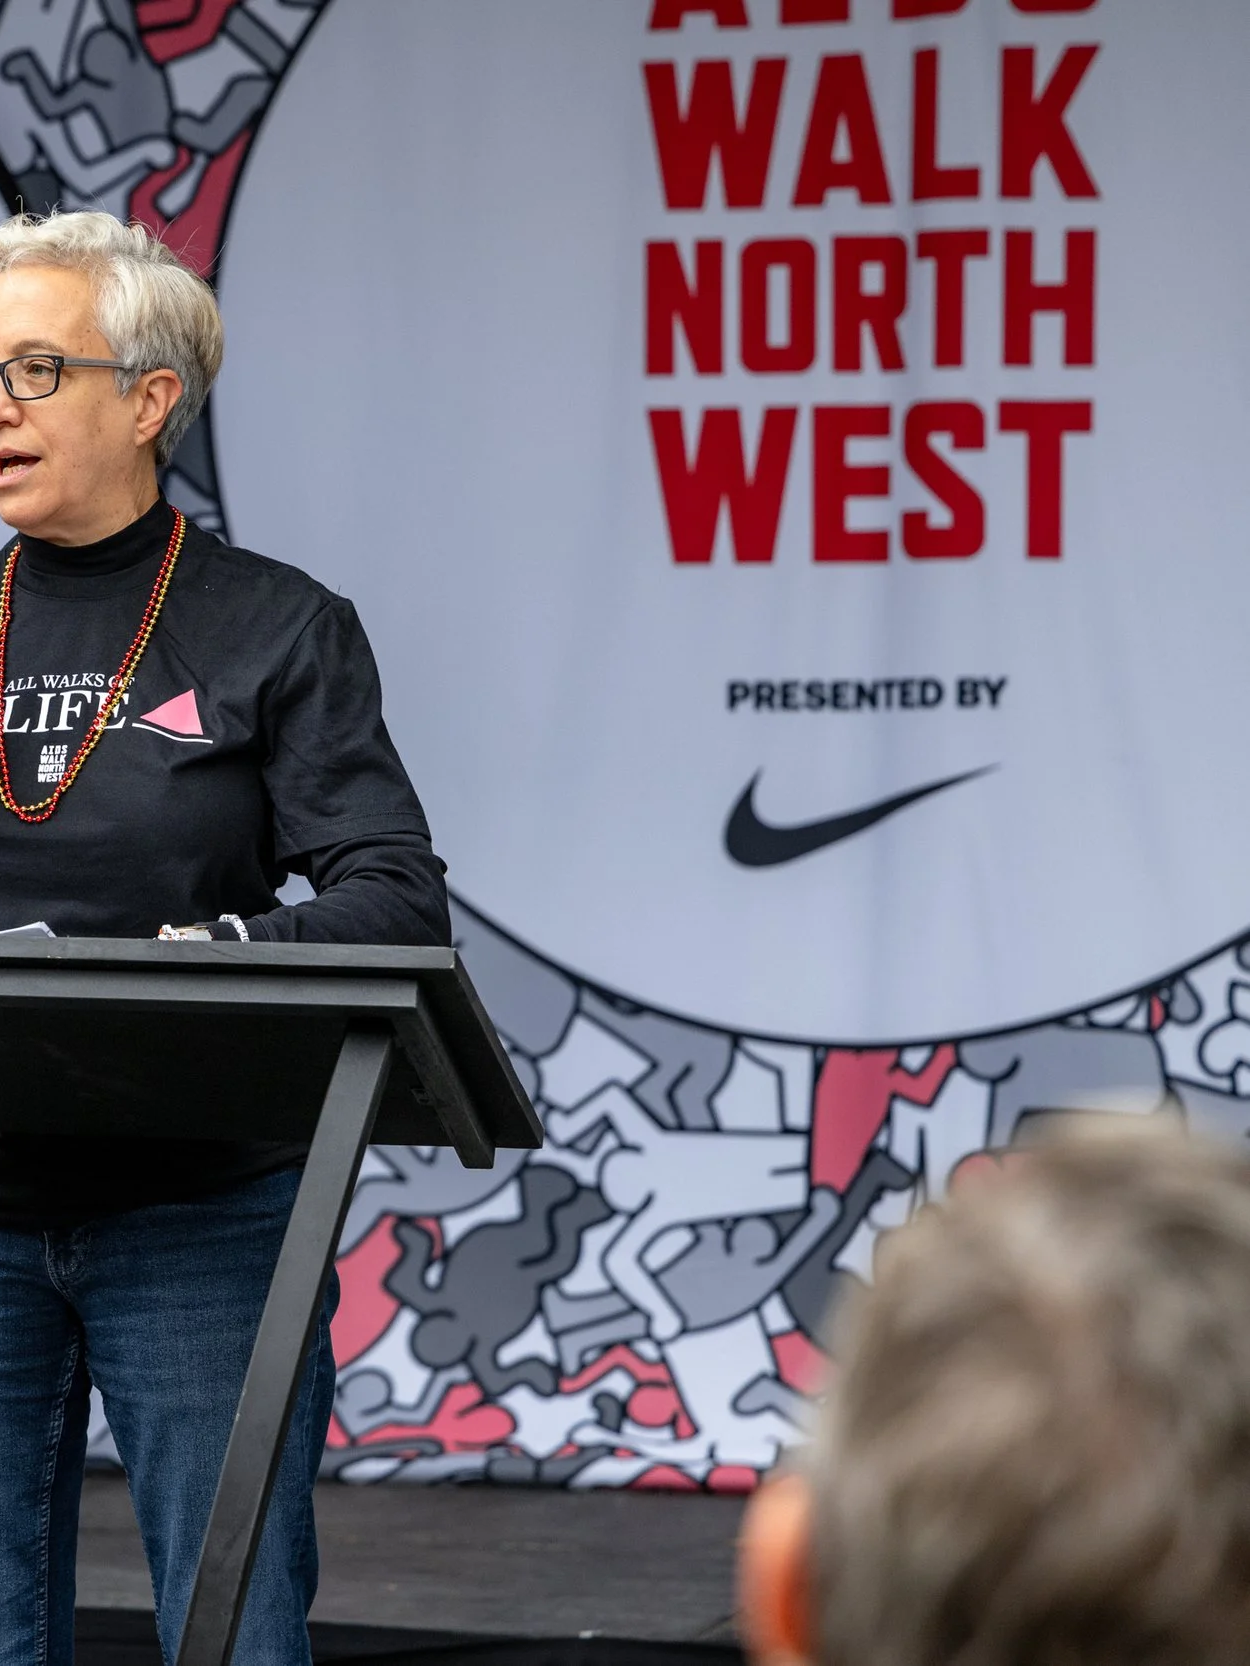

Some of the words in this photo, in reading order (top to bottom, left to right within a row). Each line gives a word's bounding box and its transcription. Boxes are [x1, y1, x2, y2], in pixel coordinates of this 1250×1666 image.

[642, 44, 1100, 211] WALK
[645, 228, 1097, 376] NORTH
[647, 400, 1094, 564] WEST
[4, 676, 37, 693] ALL
[42, 673, 105, 689] WALKS
[727, 678, 945, 712] PRESENTED
[956, 676, 1007, 708] BY
[3, 690, 129, 733] LIFE
[40, 754, 67, 764] WALK
[41, 745, 68, 755] AIDS
[37, 773, 65, 783] WEST
[38, 764, 65, 773] NORTH
